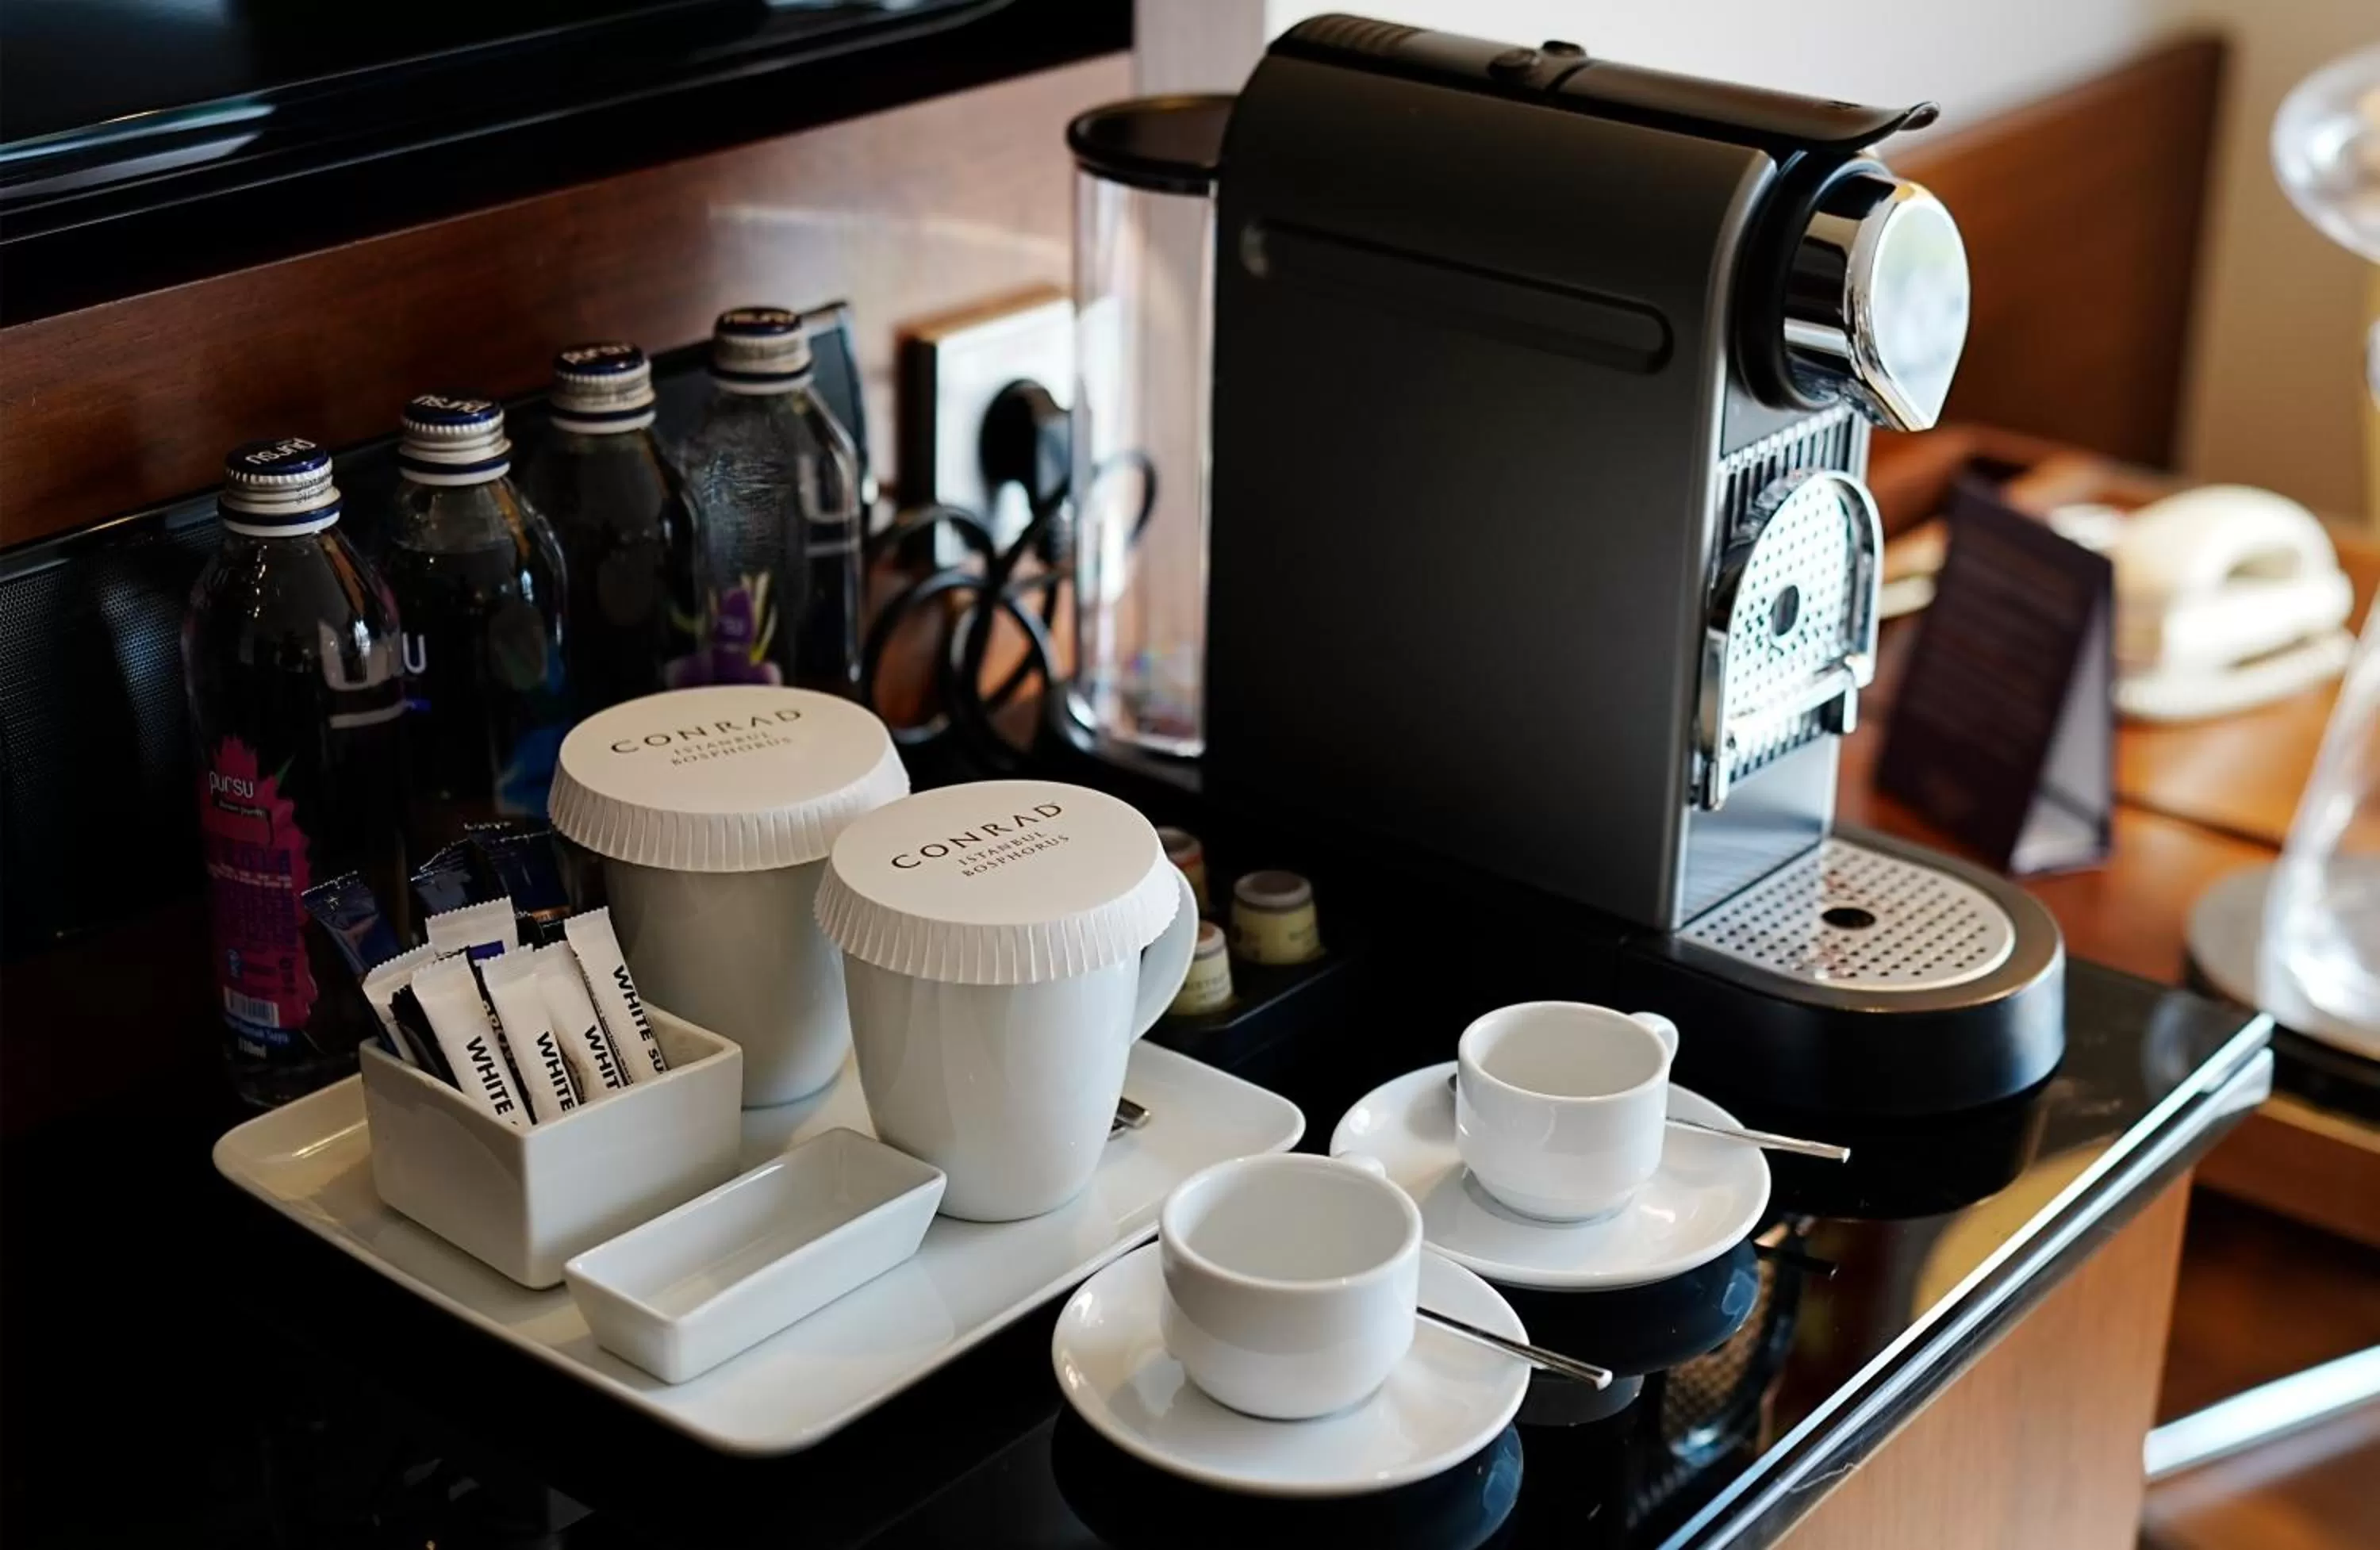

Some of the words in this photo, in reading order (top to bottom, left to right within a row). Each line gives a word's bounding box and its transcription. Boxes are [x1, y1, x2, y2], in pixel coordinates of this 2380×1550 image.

[610, 708, 801, 754] CONRAD
[209, 770, 255, 799] pursu
[891, 803, 1061, 869] CONRAD
[958, 831, 1046, 866] ISTANBUL
[962, 834, 1069, 877] BOSPHORUS
[612, 965, 652, 1042] WHITE
[647, 1048, 665, 1075] SU
[466, 1036, 514, 1115] WHITE
[536, 1031, 576, 1111] WHITE
[584, 1024, 621, 1089] WHIT
